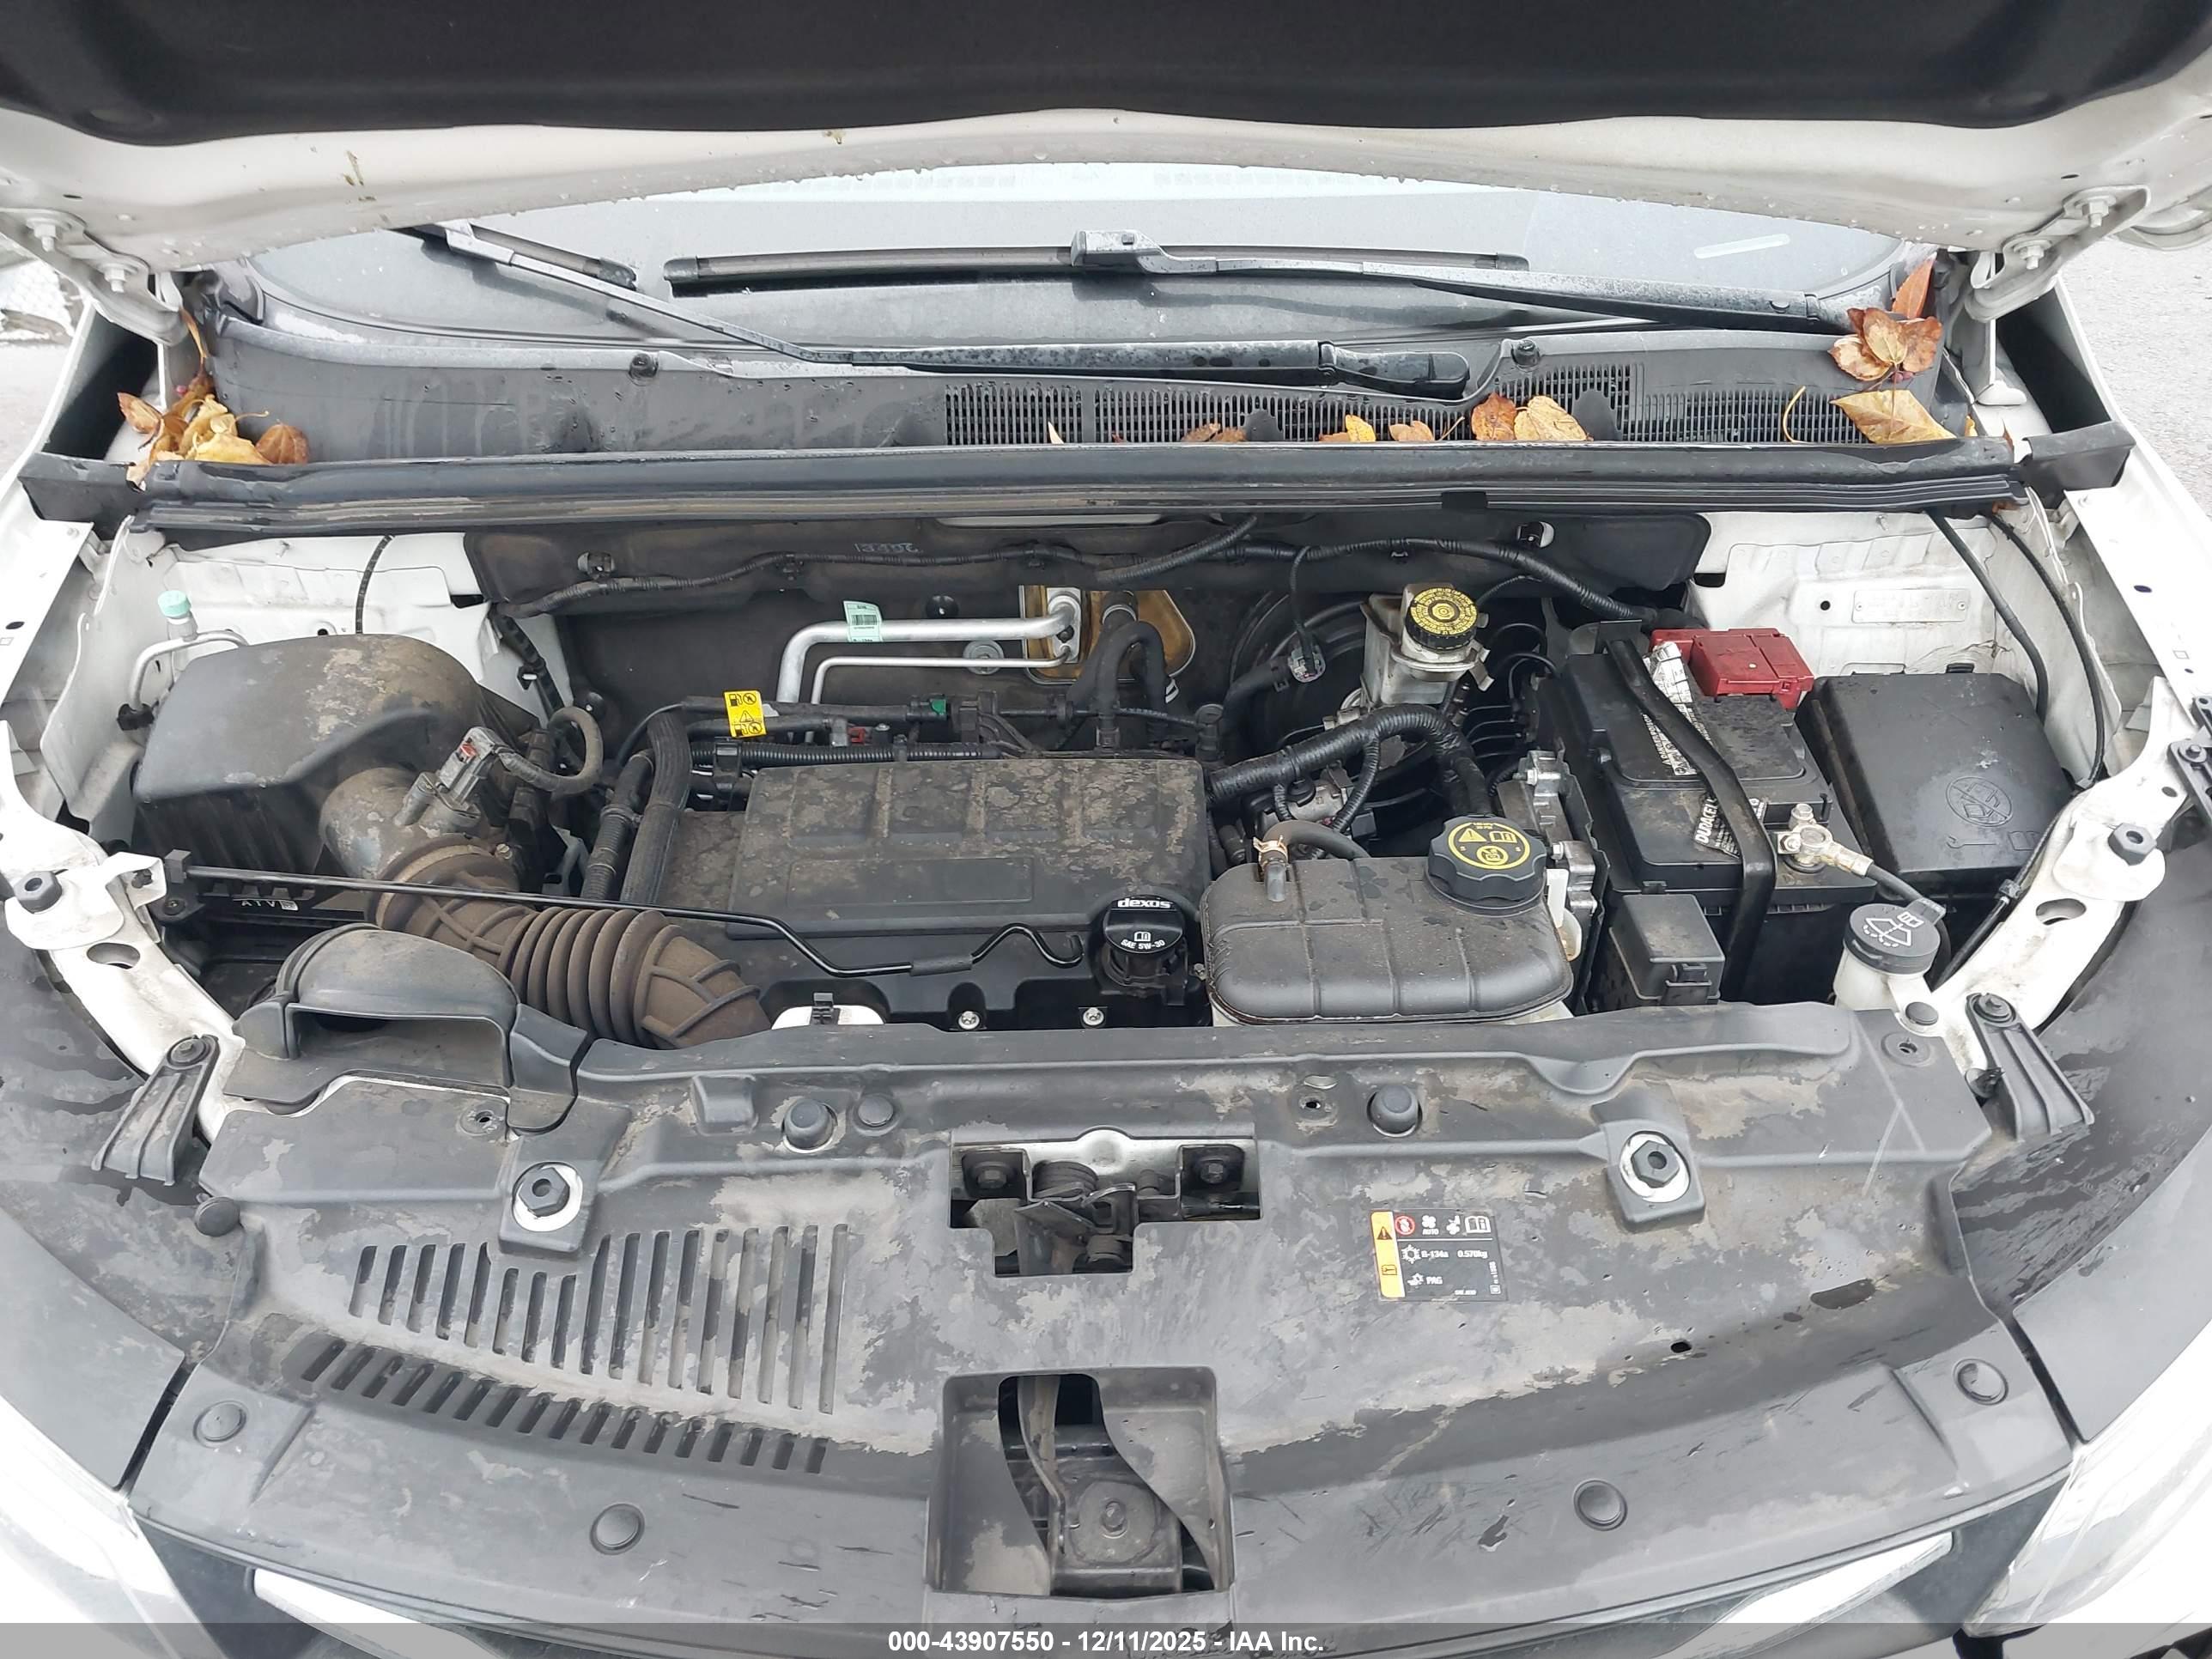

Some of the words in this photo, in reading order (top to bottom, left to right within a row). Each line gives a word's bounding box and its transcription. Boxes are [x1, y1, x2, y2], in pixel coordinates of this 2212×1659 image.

[1118, 898, 1171, 908] dexos
[1121, 939, 1137, 949] SAE
[1138, 939, 1165, 950] 5W-30
